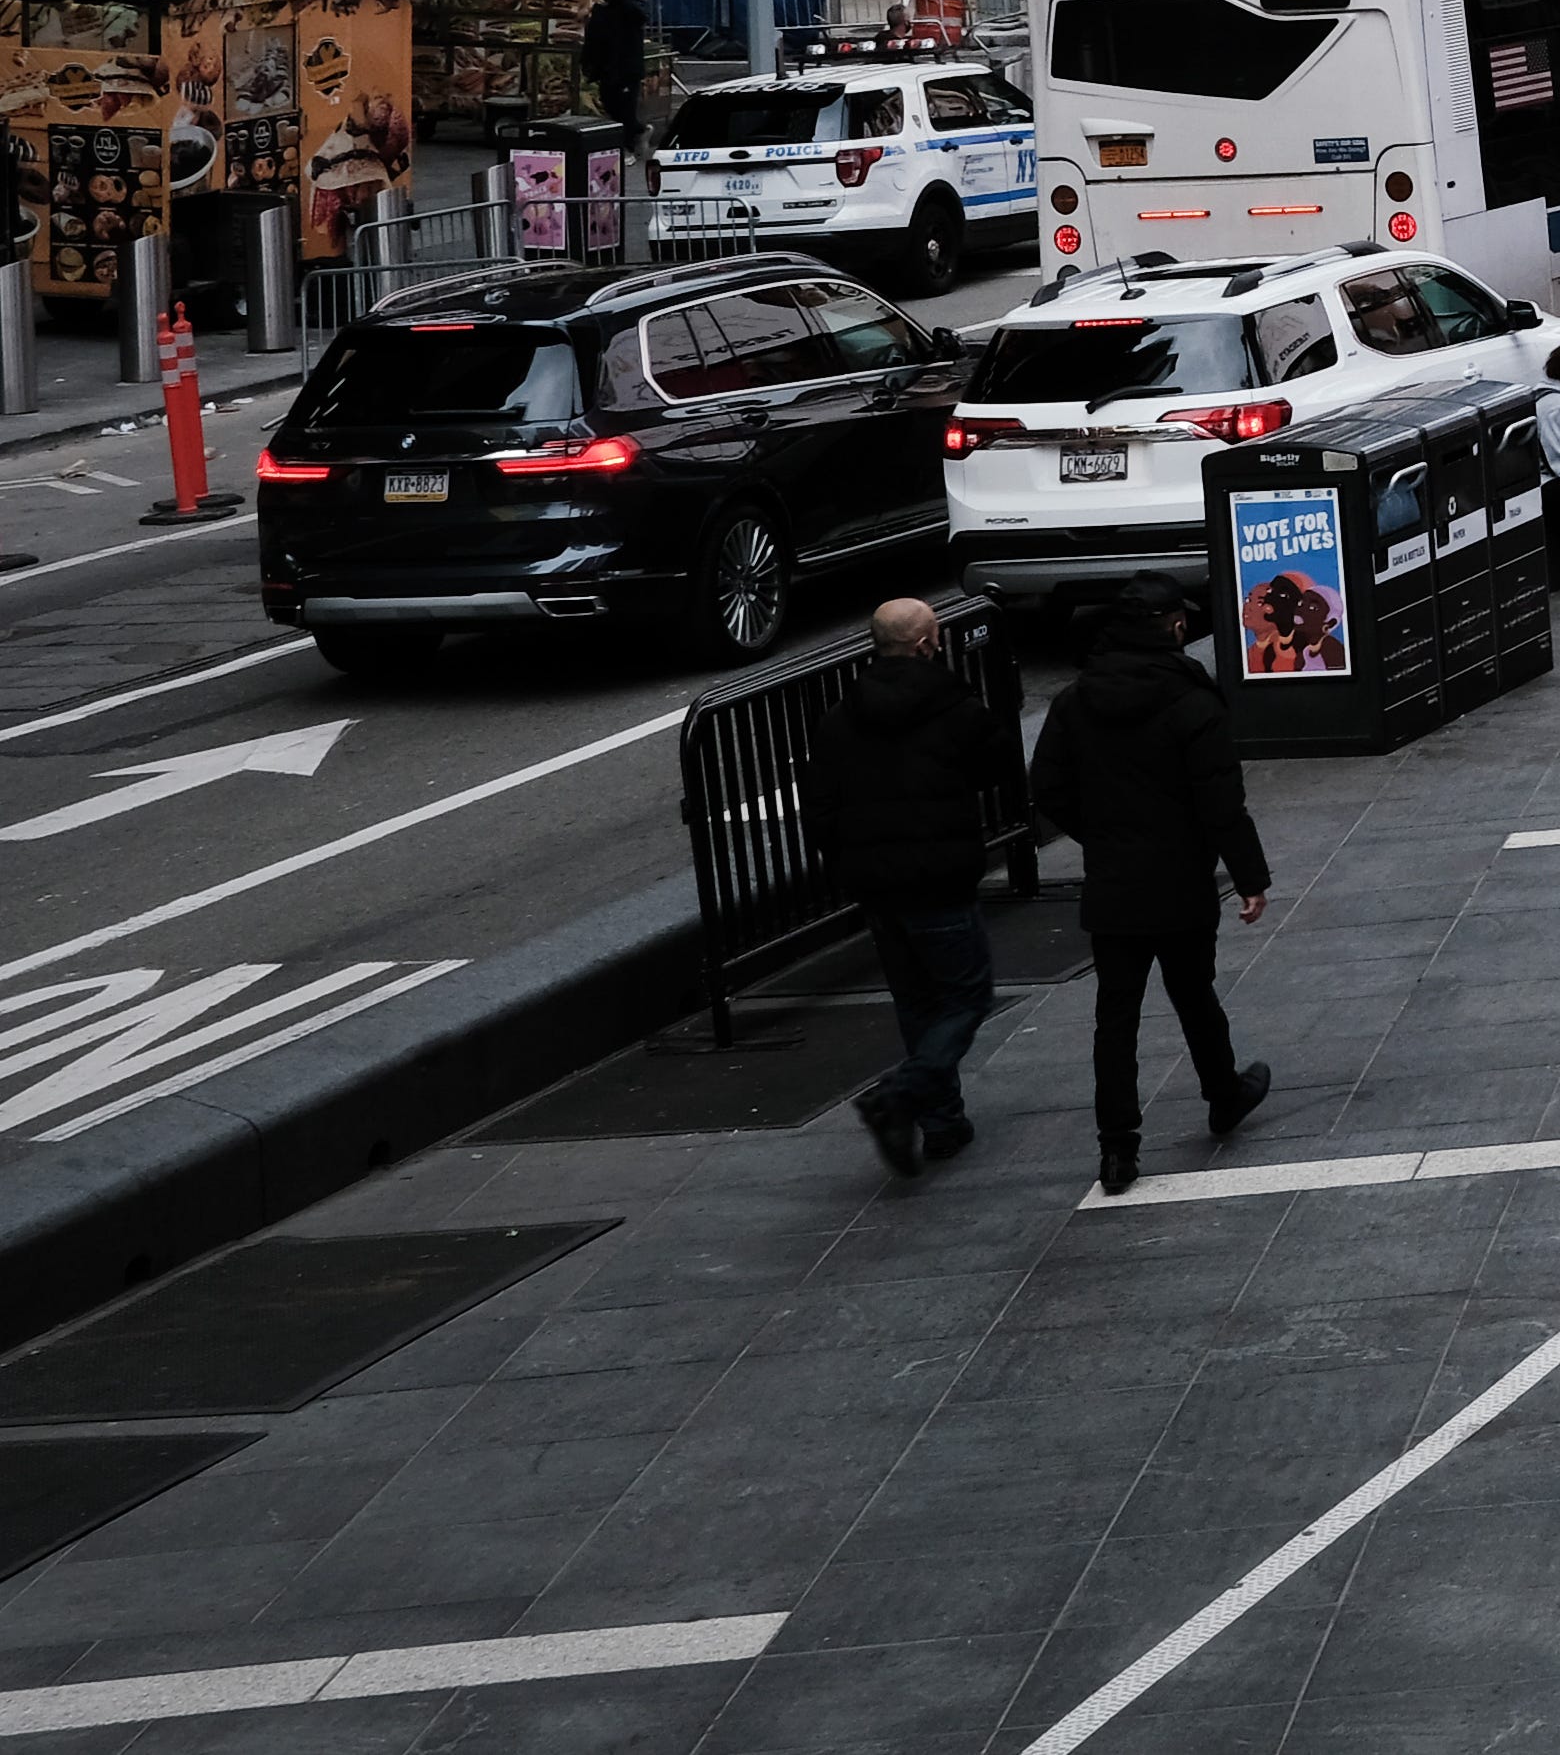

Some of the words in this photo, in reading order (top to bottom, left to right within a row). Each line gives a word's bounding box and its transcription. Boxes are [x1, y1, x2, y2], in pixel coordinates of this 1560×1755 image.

[673, 150, 711, 162] NYPD
[765, 145, 823, 158] POLICE
[1242, 517, 1291, 544] VOTE
[1293, 511, 1330, 536] FOR
[1241, 541, 1278, 563] OUR
[1281, 531, 1336, 558] LIVES
